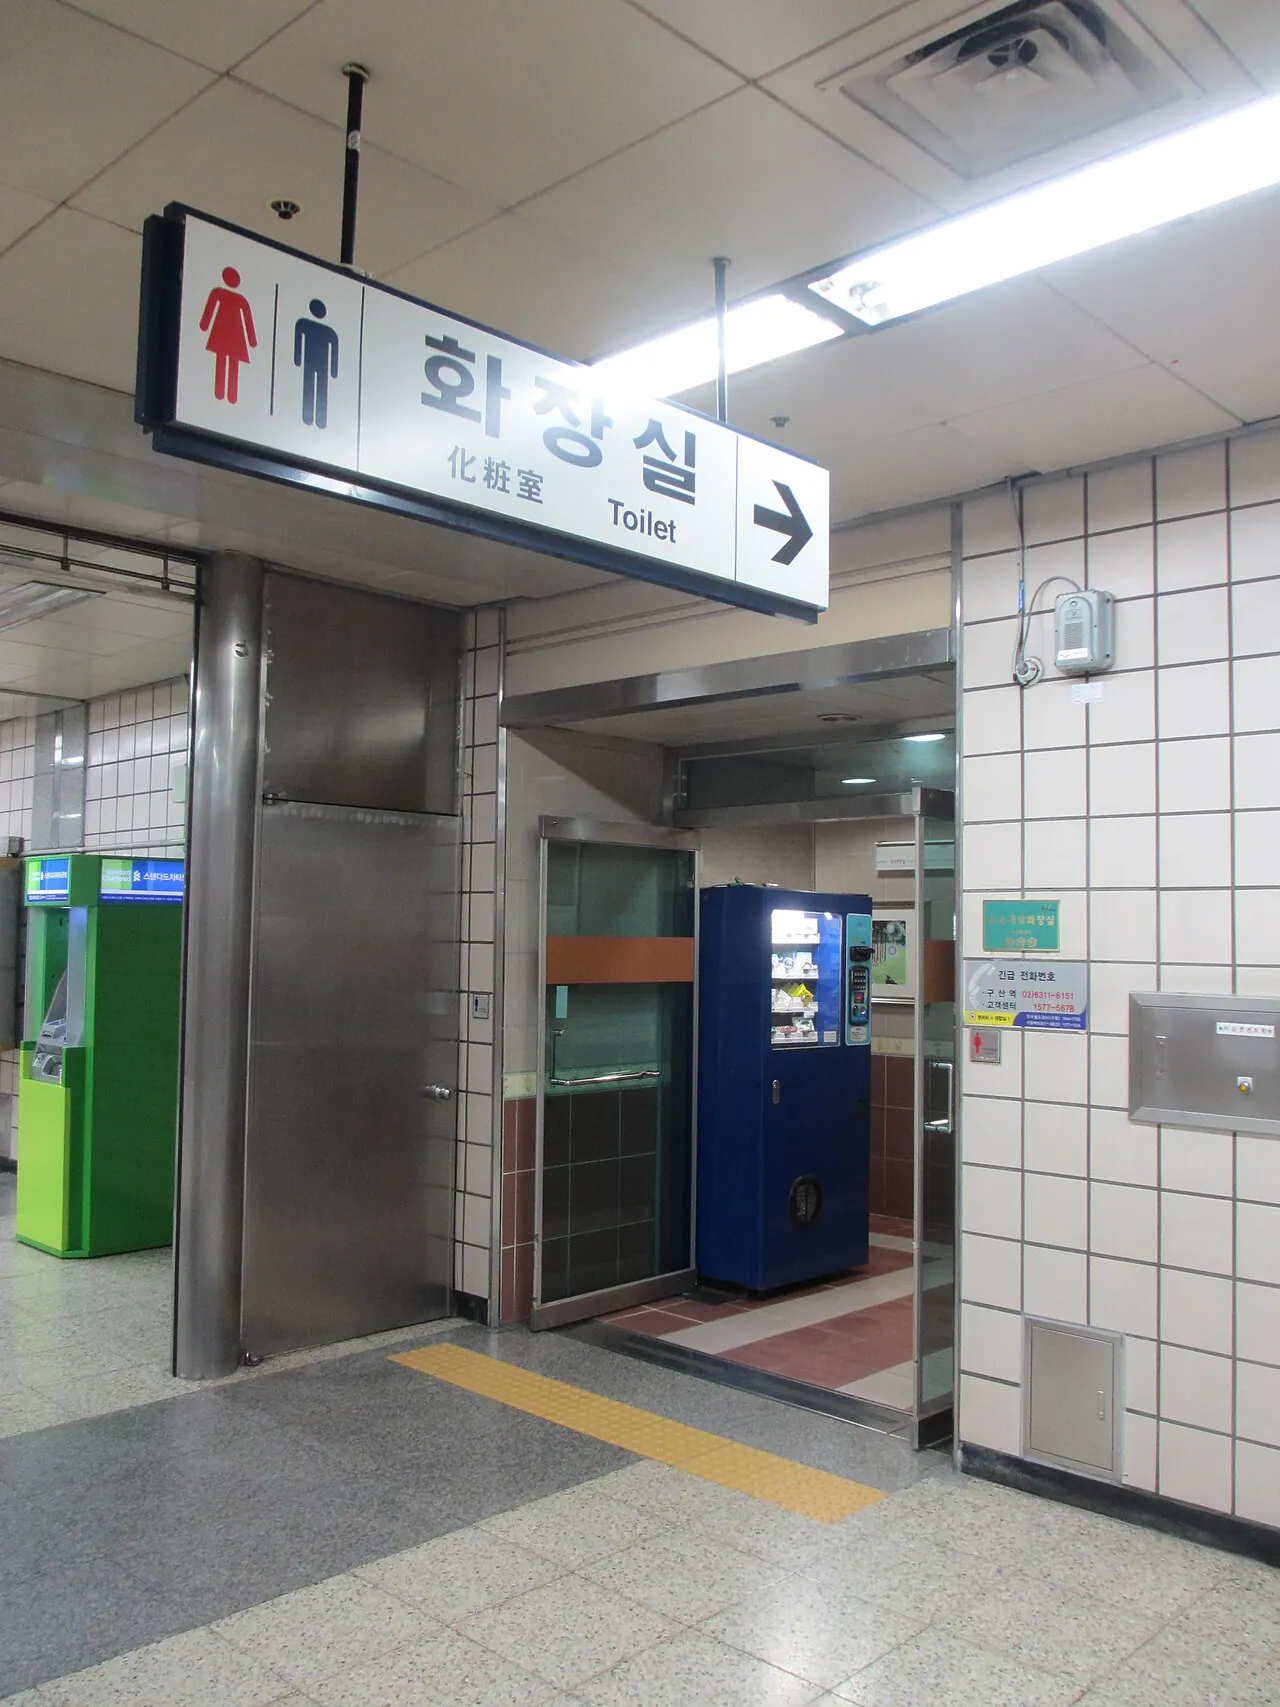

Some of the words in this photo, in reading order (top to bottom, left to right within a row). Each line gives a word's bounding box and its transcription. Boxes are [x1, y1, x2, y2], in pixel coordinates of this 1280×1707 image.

[420, 333, 696, 505] 화장실
[447, 446, 545, 505] 化粧室
[607, 497, 678, 544] Toilet
[998, 970, 1015, 980] 긴급
[1020, 971, 1056, 982] 전화번호
[987, 1001, 1016, 1010] 고객센터
[1034, 1003, 1075, 1012] 1577-5678
